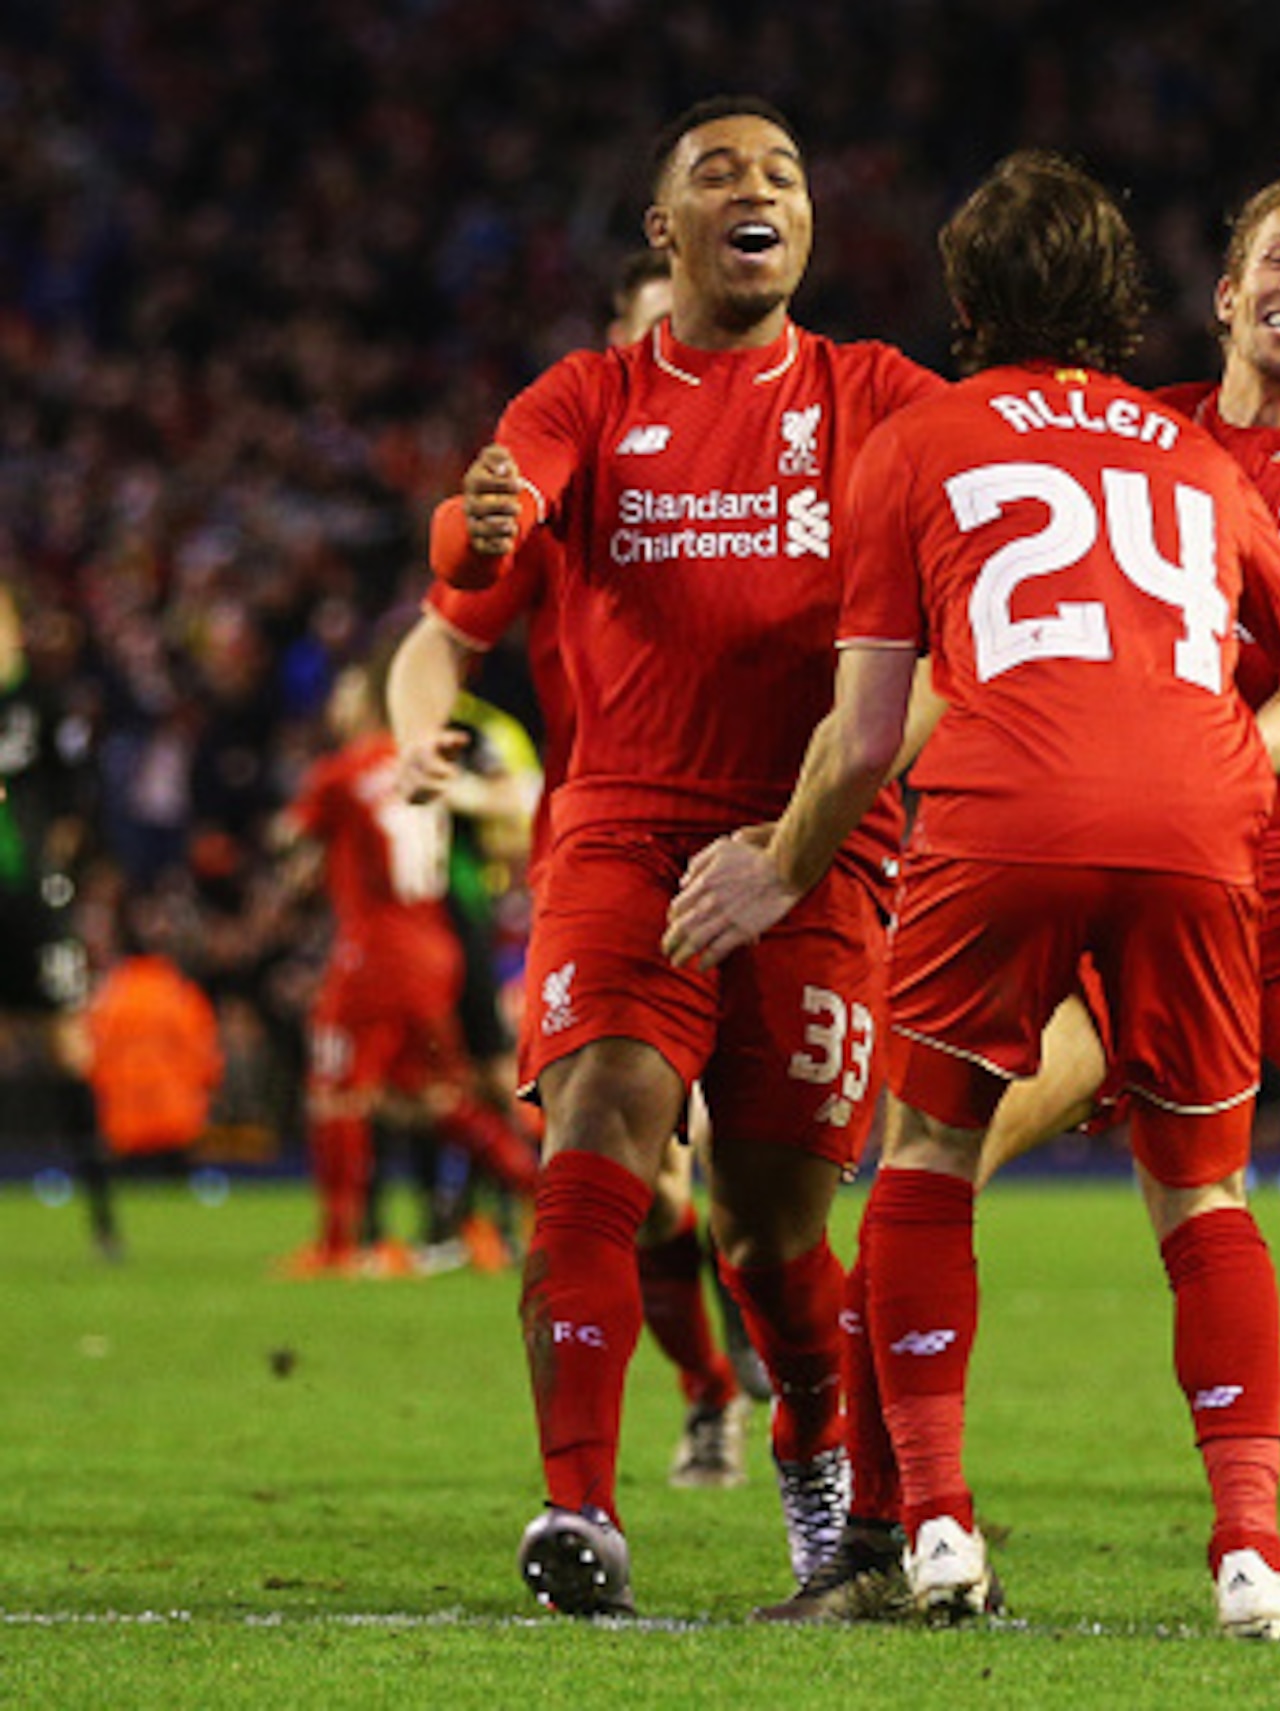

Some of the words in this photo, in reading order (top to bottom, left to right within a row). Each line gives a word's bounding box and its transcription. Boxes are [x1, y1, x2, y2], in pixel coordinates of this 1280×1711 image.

[618, 486, 778, 524] Standard
[610, 526, 778, 565] Chartered
[944, 462, 1229, 695] 24
[788, 984, 875, 1102] 33
